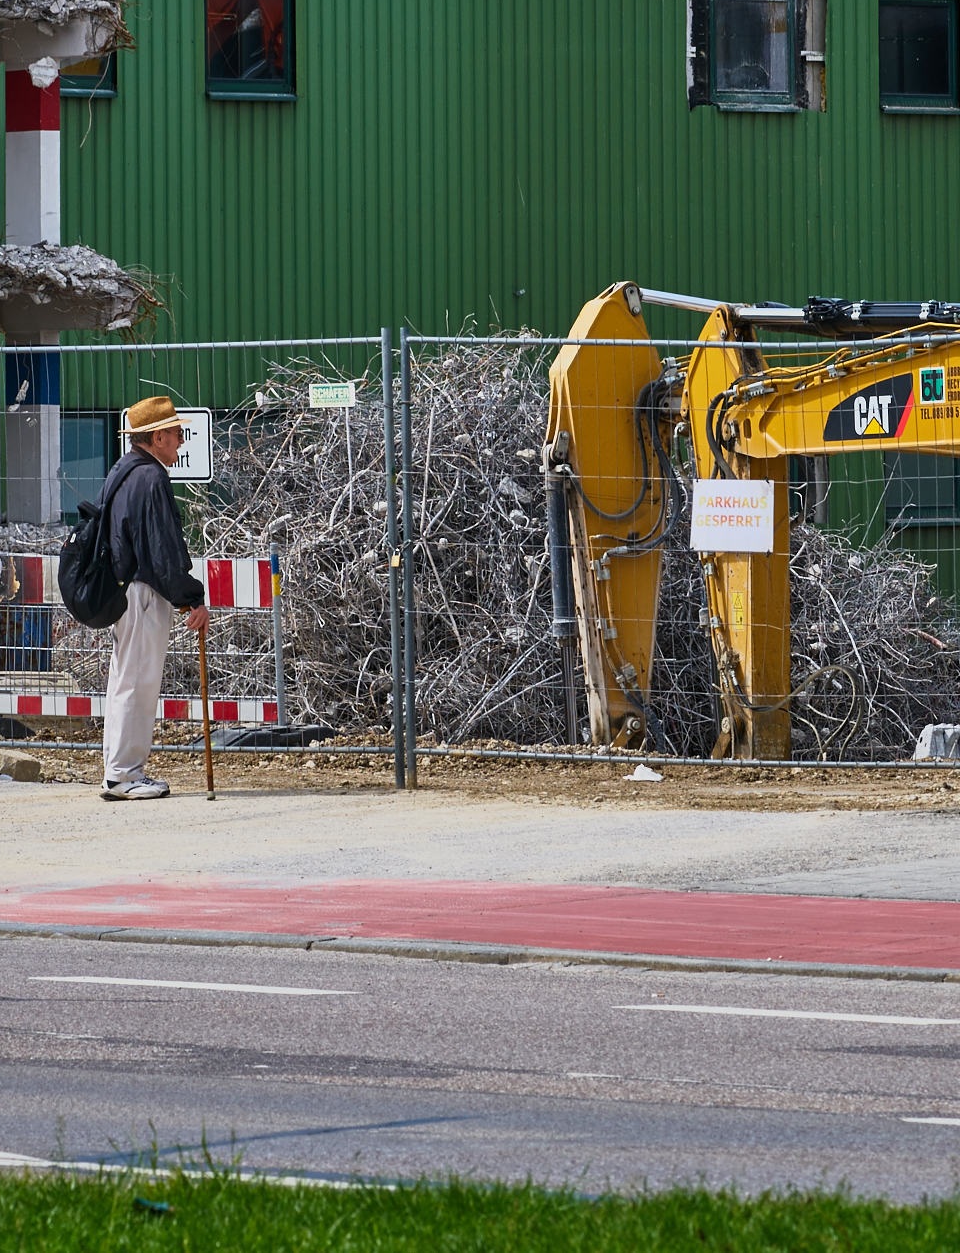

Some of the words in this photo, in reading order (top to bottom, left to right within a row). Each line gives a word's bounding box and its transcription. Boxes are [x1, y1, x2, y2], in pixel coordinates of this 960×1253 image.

[854, 395, 892, 436] CAT
[699, 496, 768, 509] PARKHAUS
[695, 514, 762, 527] GESPERRT
